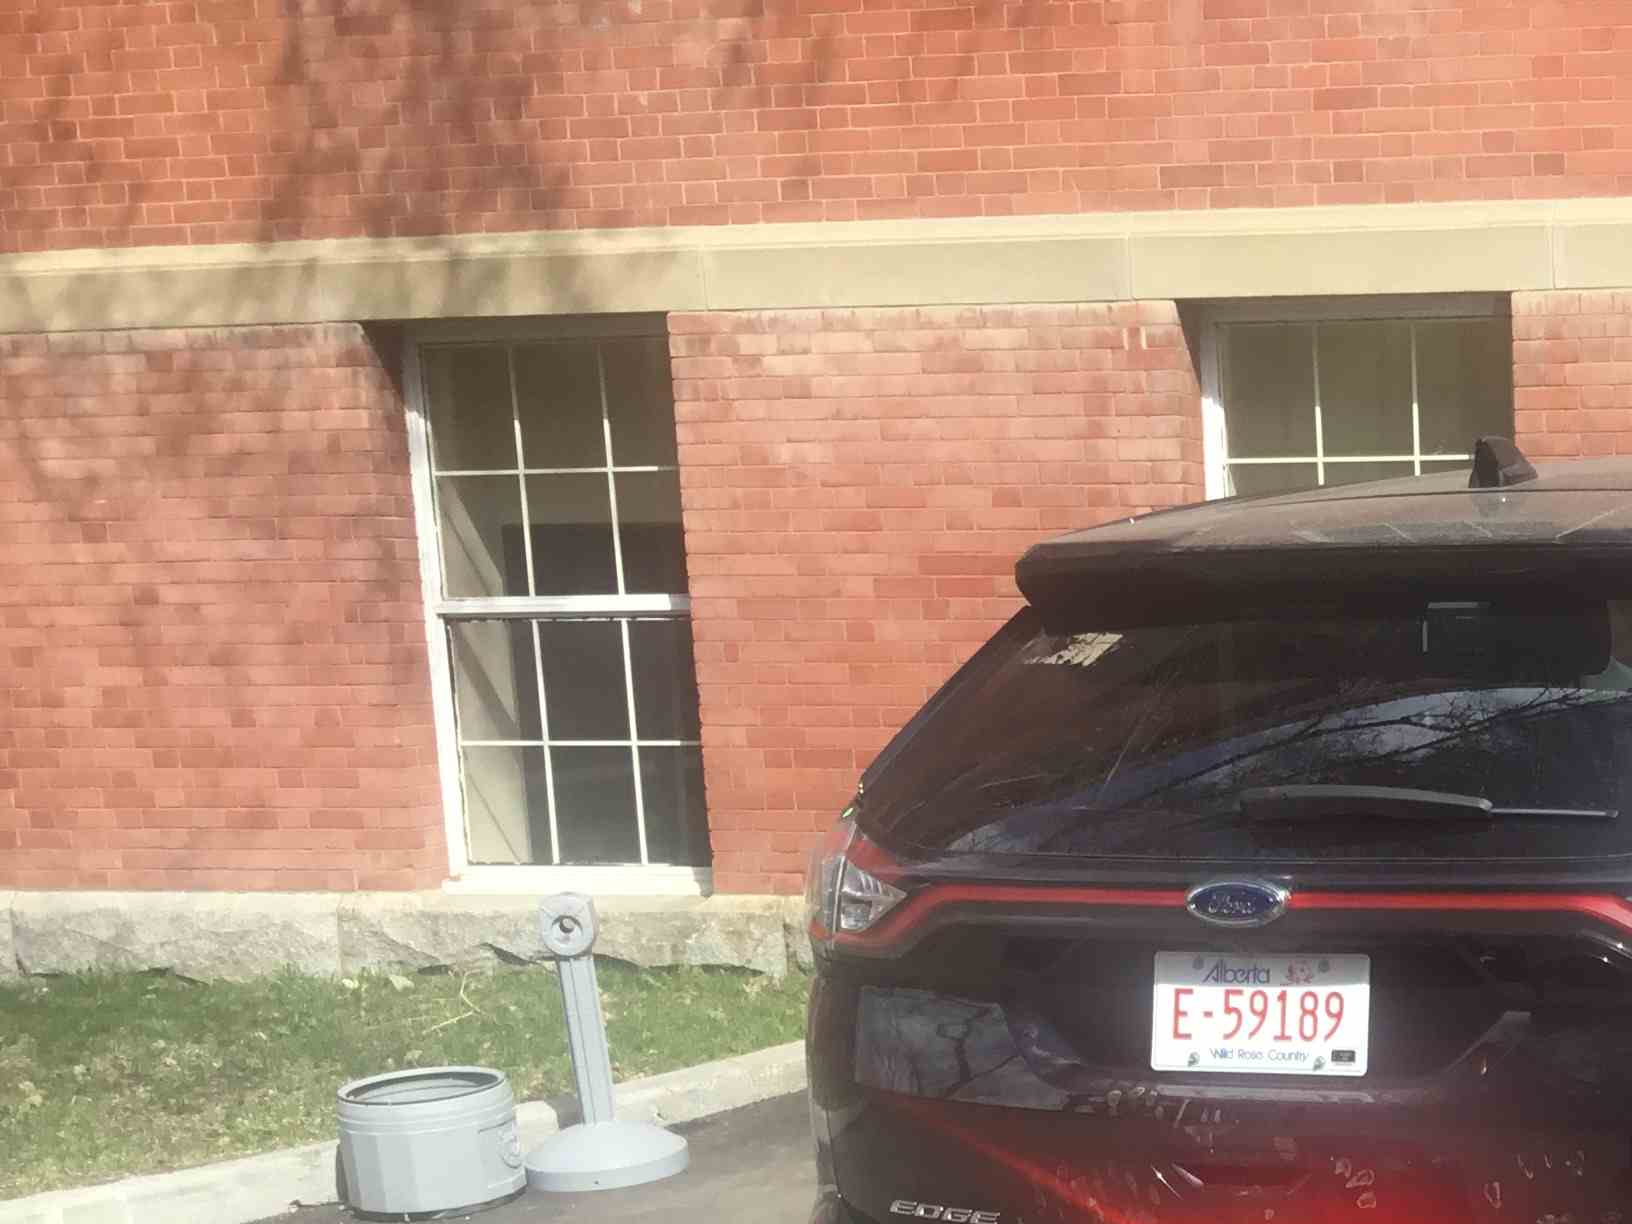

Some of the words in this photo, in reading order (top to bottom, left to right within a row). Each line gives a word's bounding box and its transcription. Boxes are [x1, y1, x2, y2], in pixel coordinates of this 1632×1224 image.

[1202, 959, 1271, 984] Alberta
[1172, 987, 1345, 1042] E-59189
[1267, 1048, 1310, 1063] Country
